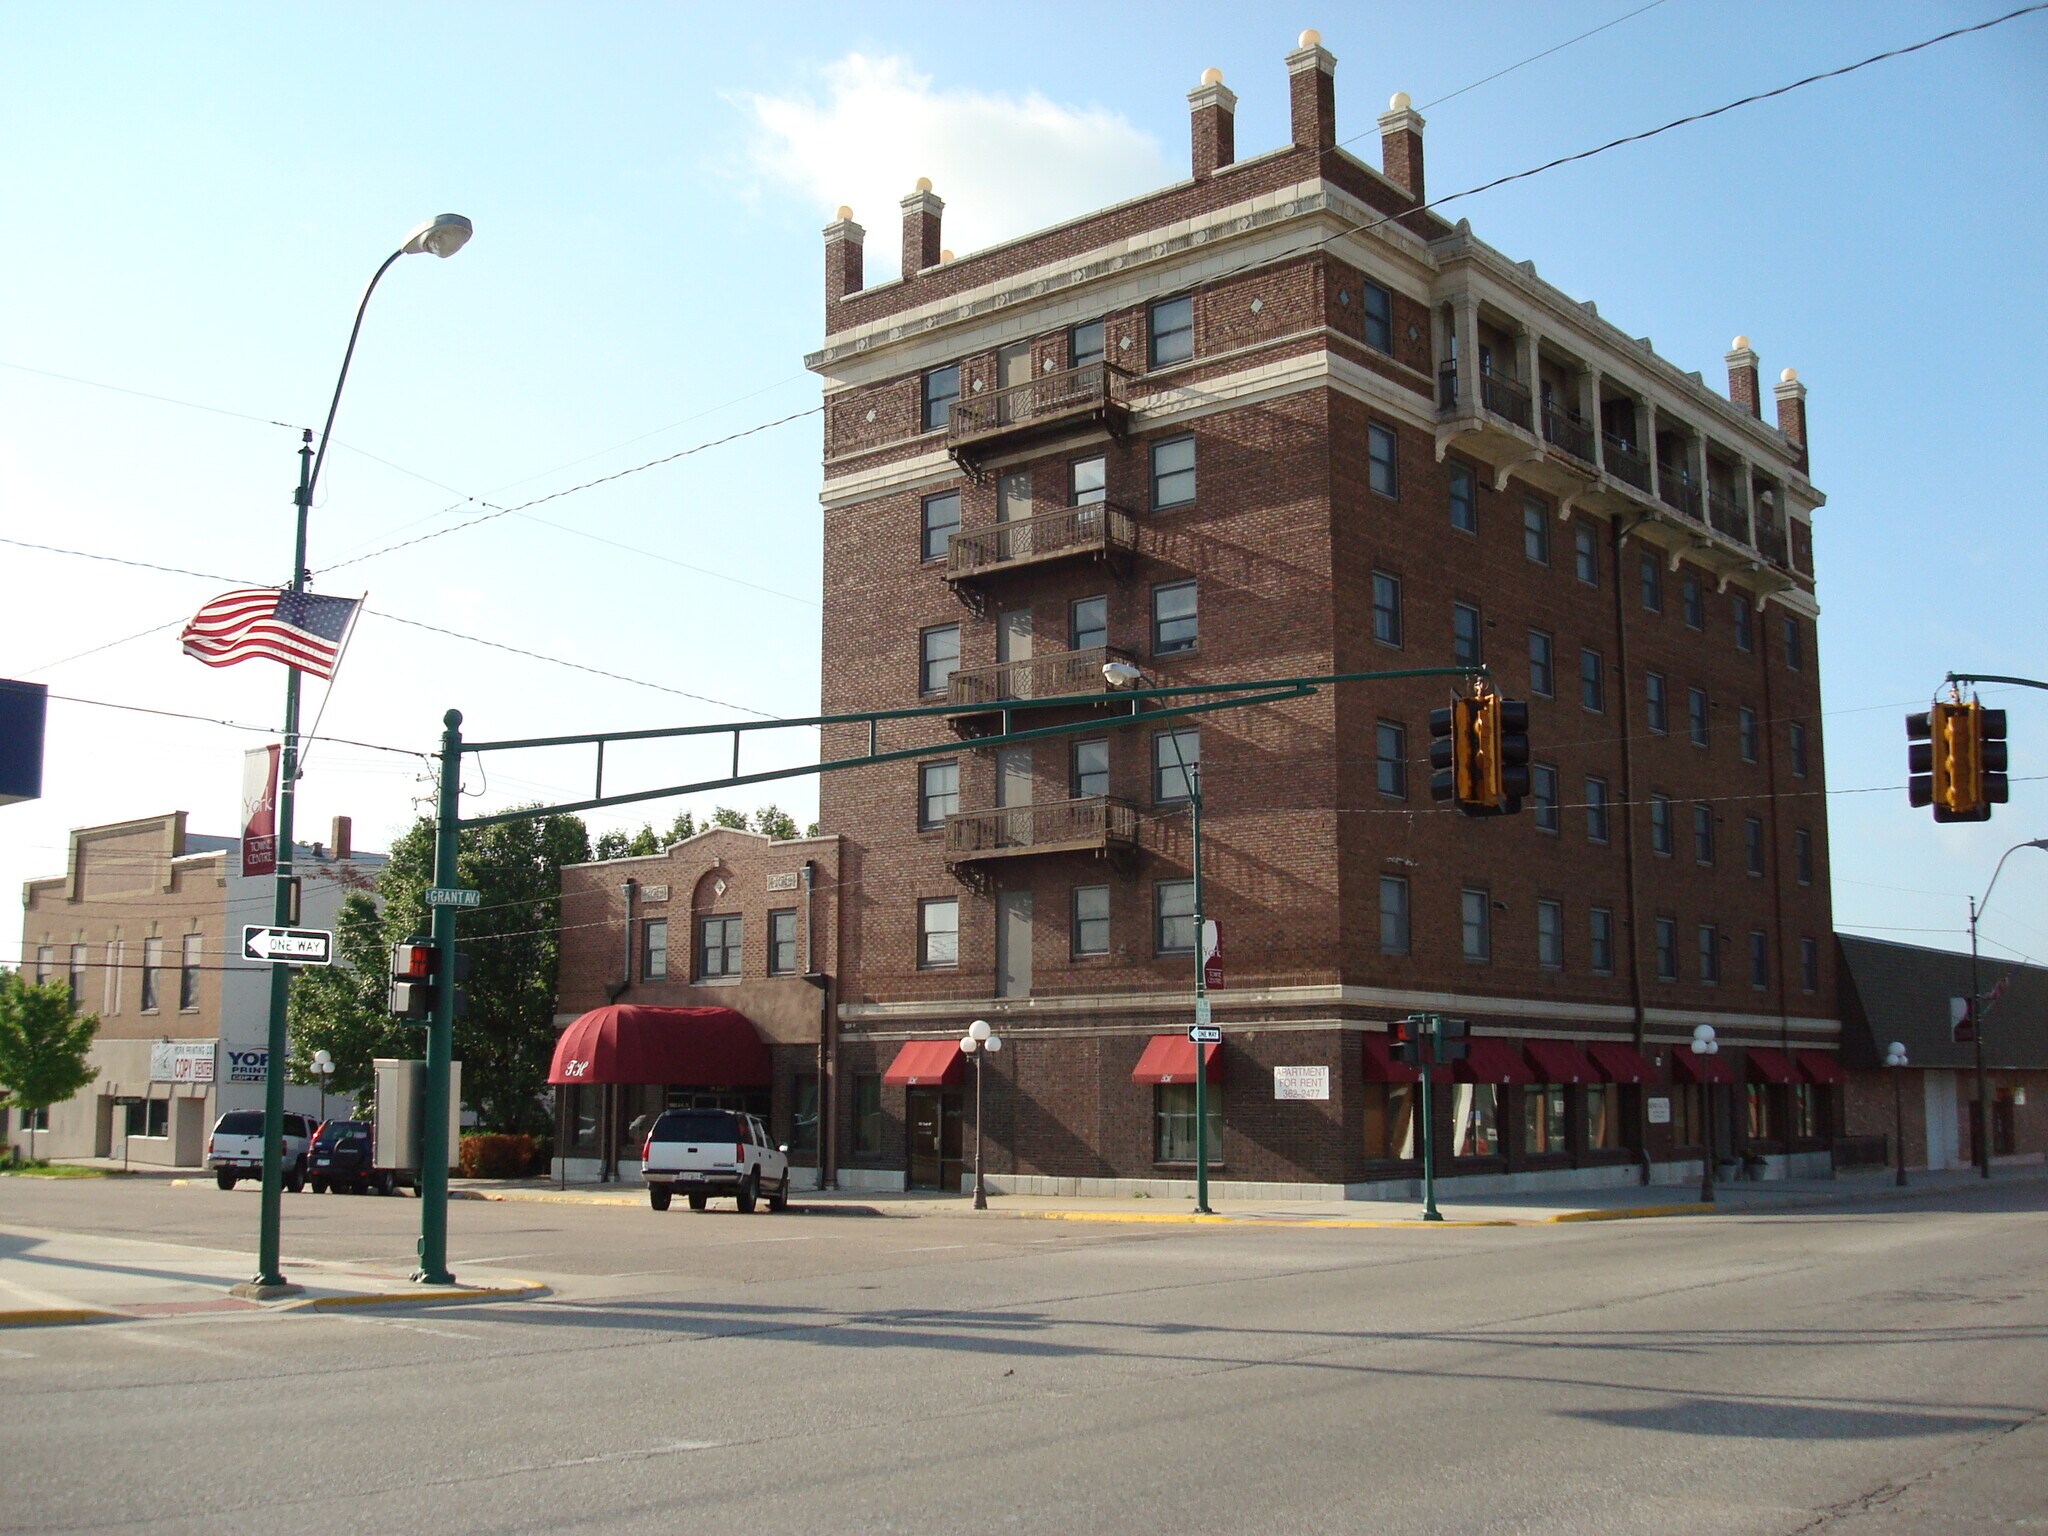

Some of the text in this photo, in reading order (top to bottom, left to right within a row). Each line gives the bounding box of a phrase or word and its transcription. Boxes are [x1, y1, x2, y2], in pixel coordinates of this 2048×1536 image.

[243, 786, 273, 814] York
[247, 852, 273, 865] CENTRE
[430, 890, 463, 903] GRANT
[270, 938, 321, 953] ONE WAY
[228, 1051, 290, 1067] YOR
[175, 1058, 193, 1078] COPY
[1276, 1067, 1327, 1077] APARTMENT
[1279, 1078, 1323, 1087] FOR RENT
[1283, 1089, 1320, 1098] 362-2477
